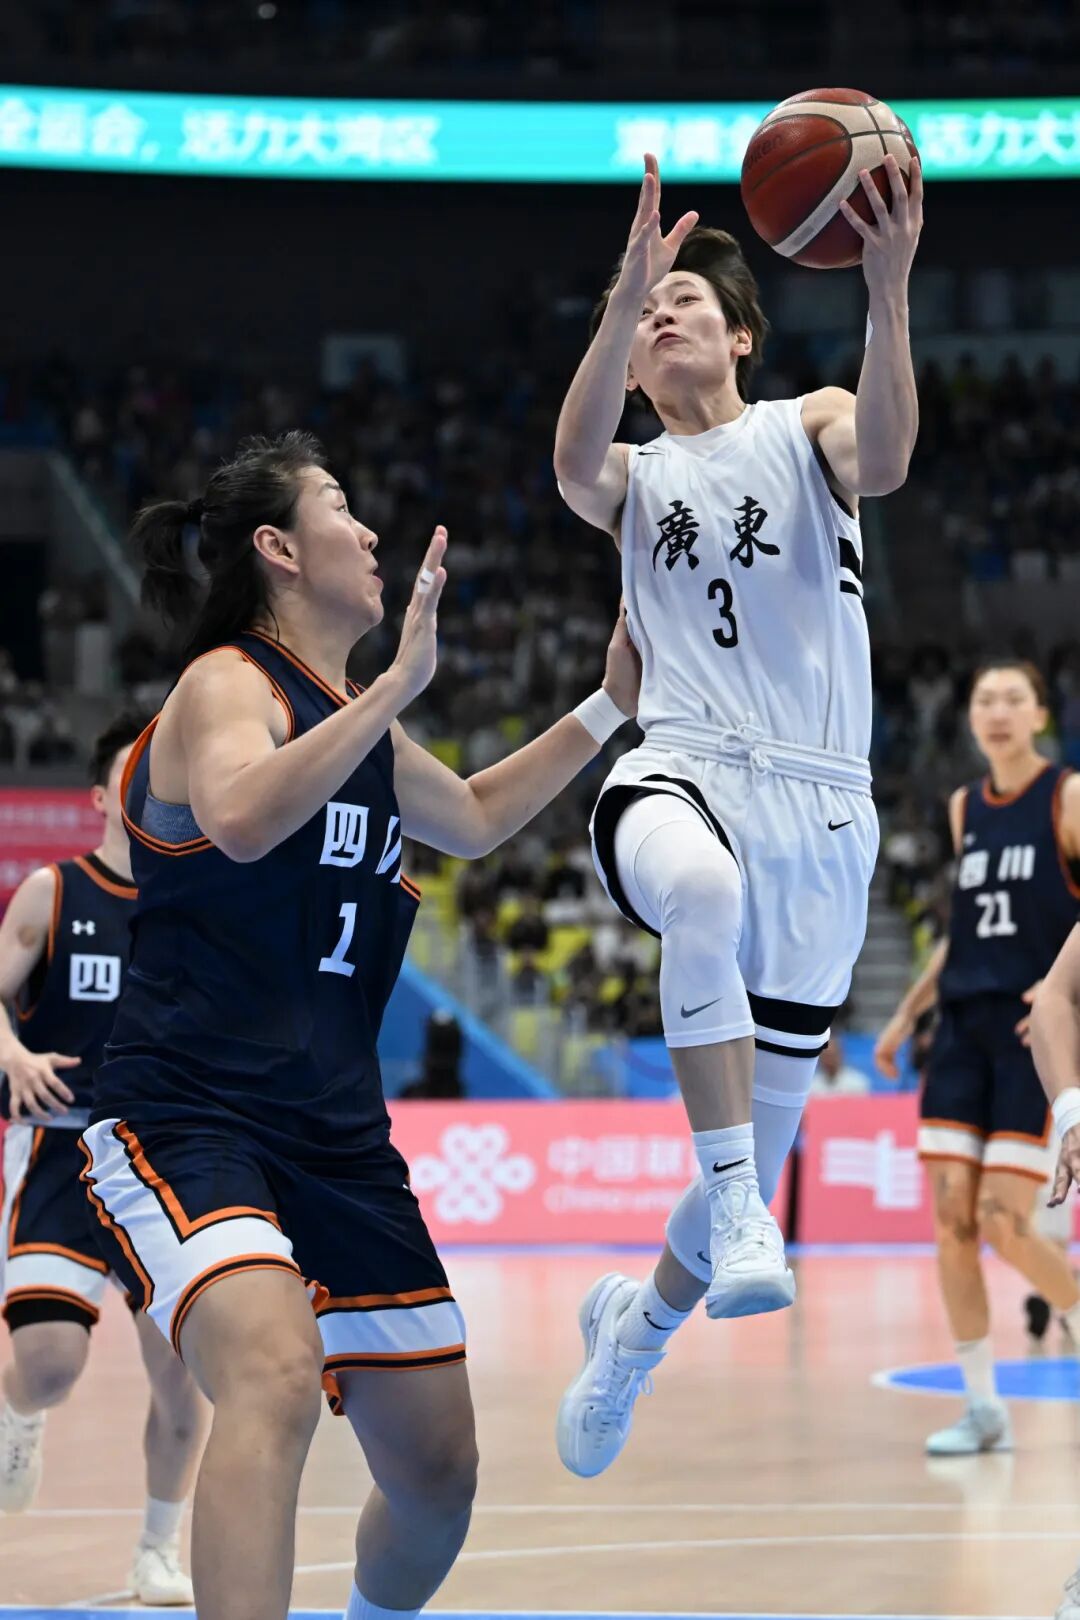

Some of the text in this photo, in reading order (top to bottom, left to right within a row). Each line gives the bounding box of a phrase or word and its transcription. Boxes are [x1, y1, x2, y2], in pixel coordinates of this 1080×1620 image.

[653, 496, 781, 572] 廣東
[707, 578, 738, 648] 3
[318, 902, 358, 977] 1
[975, 891, 1018, 938] 21
[69, 953, 121, 1002] 四
